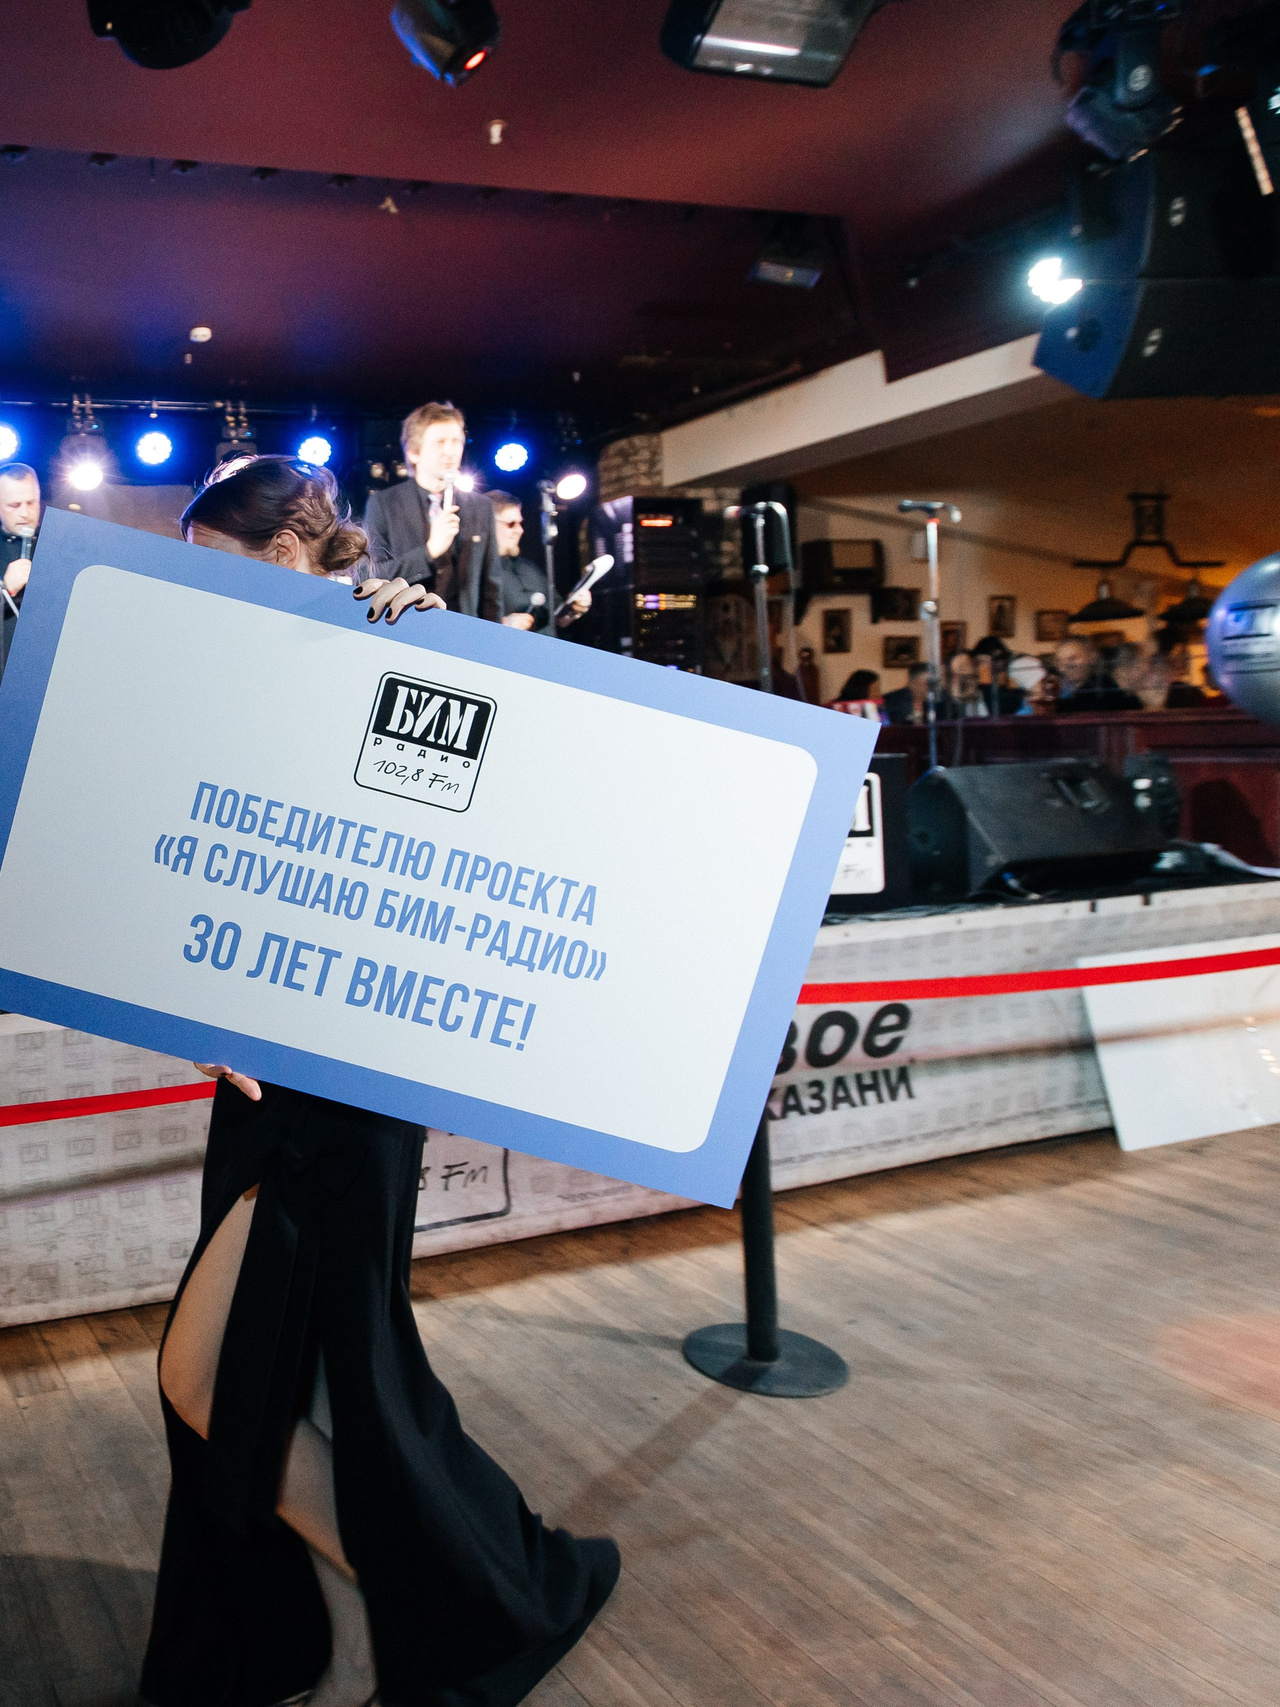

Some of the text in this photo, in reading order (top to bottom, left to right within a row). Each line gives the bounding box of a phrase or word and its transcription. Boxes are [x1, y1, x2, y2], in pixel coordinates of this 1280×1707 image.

[373, 736, 471, 769] радио
[385, 685, 479, 751] БИМ
[373, 760, 425, 786] 102,8
[190, 781, 598, 926] ПОБЕДИТЕЛЮ ПРОЕКТА
[153, 833, 607, 981] «Я СЛУШАЮ БИМ-РАДИО»
[183, 913, 537, 1052] 30 ЛЕТ ВМЕСТЕ!
